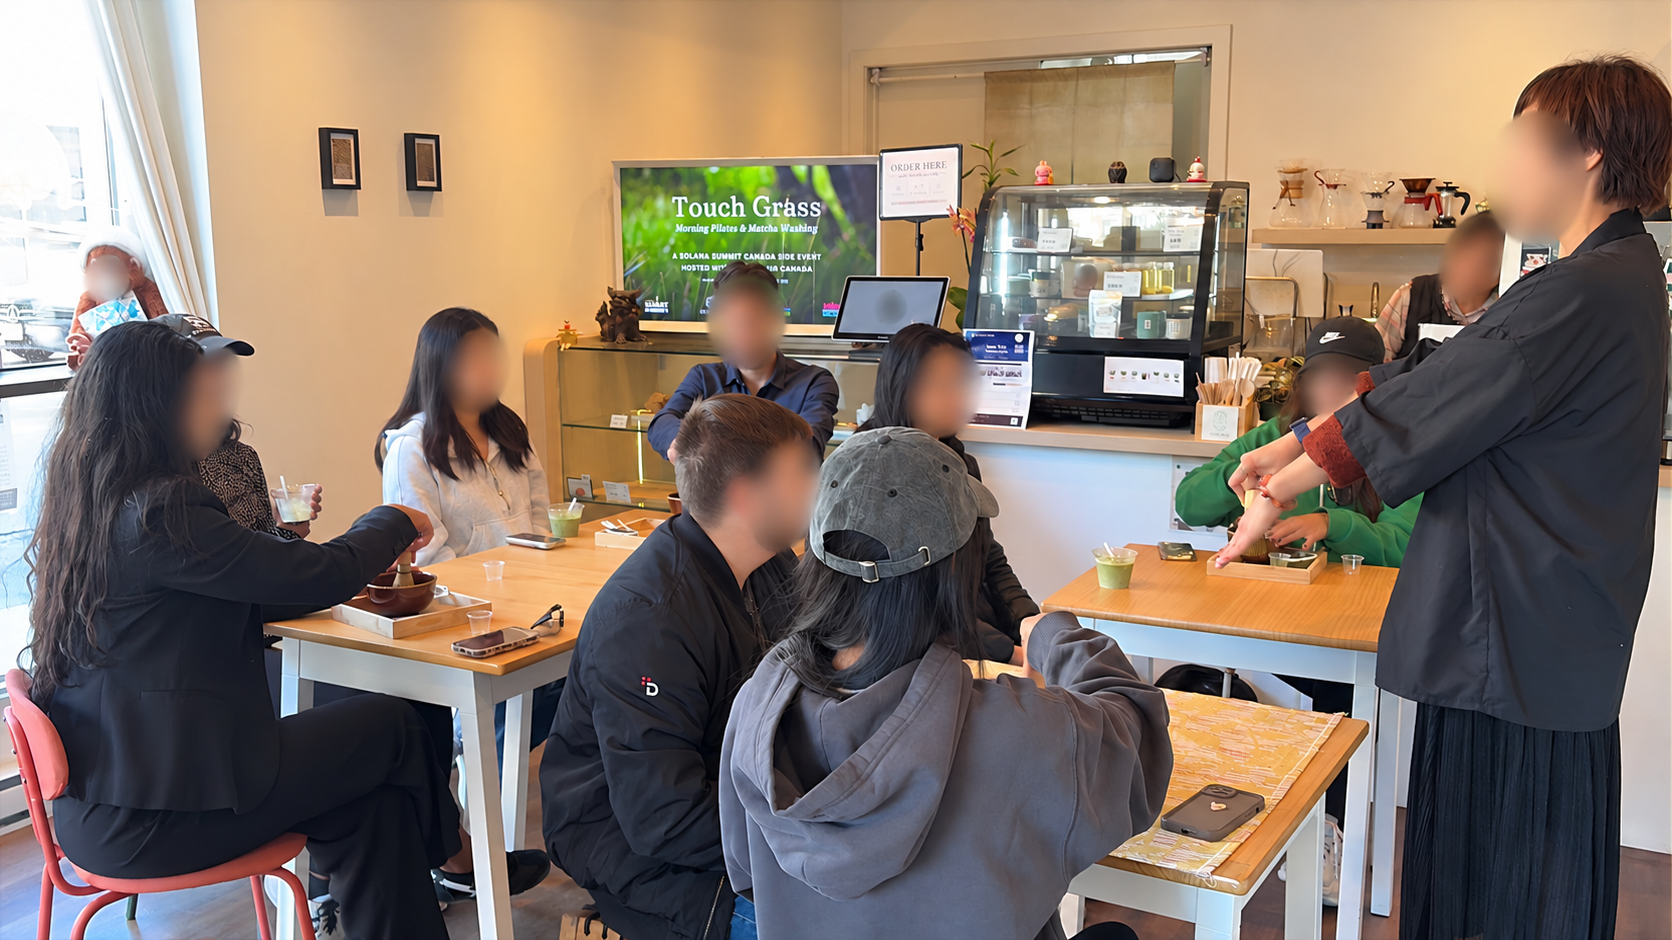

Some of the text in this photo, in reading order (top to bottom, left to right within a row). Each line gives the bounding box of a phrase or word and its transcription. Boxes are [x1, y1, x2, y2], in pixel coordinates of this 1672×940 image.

[890, 161, 947, 172] ORDER HERE
[671, 195, 821, 218] Touch Grass
[675, 223, 709, 235] Morning
[710, 224, 738, 233] Pilates
[739, 224, 747, 233] &
[747, 224, 779, 233] Matcha
[797, 253, 822, 261] EVENT
[779, 265, 813, 273] CANADA
